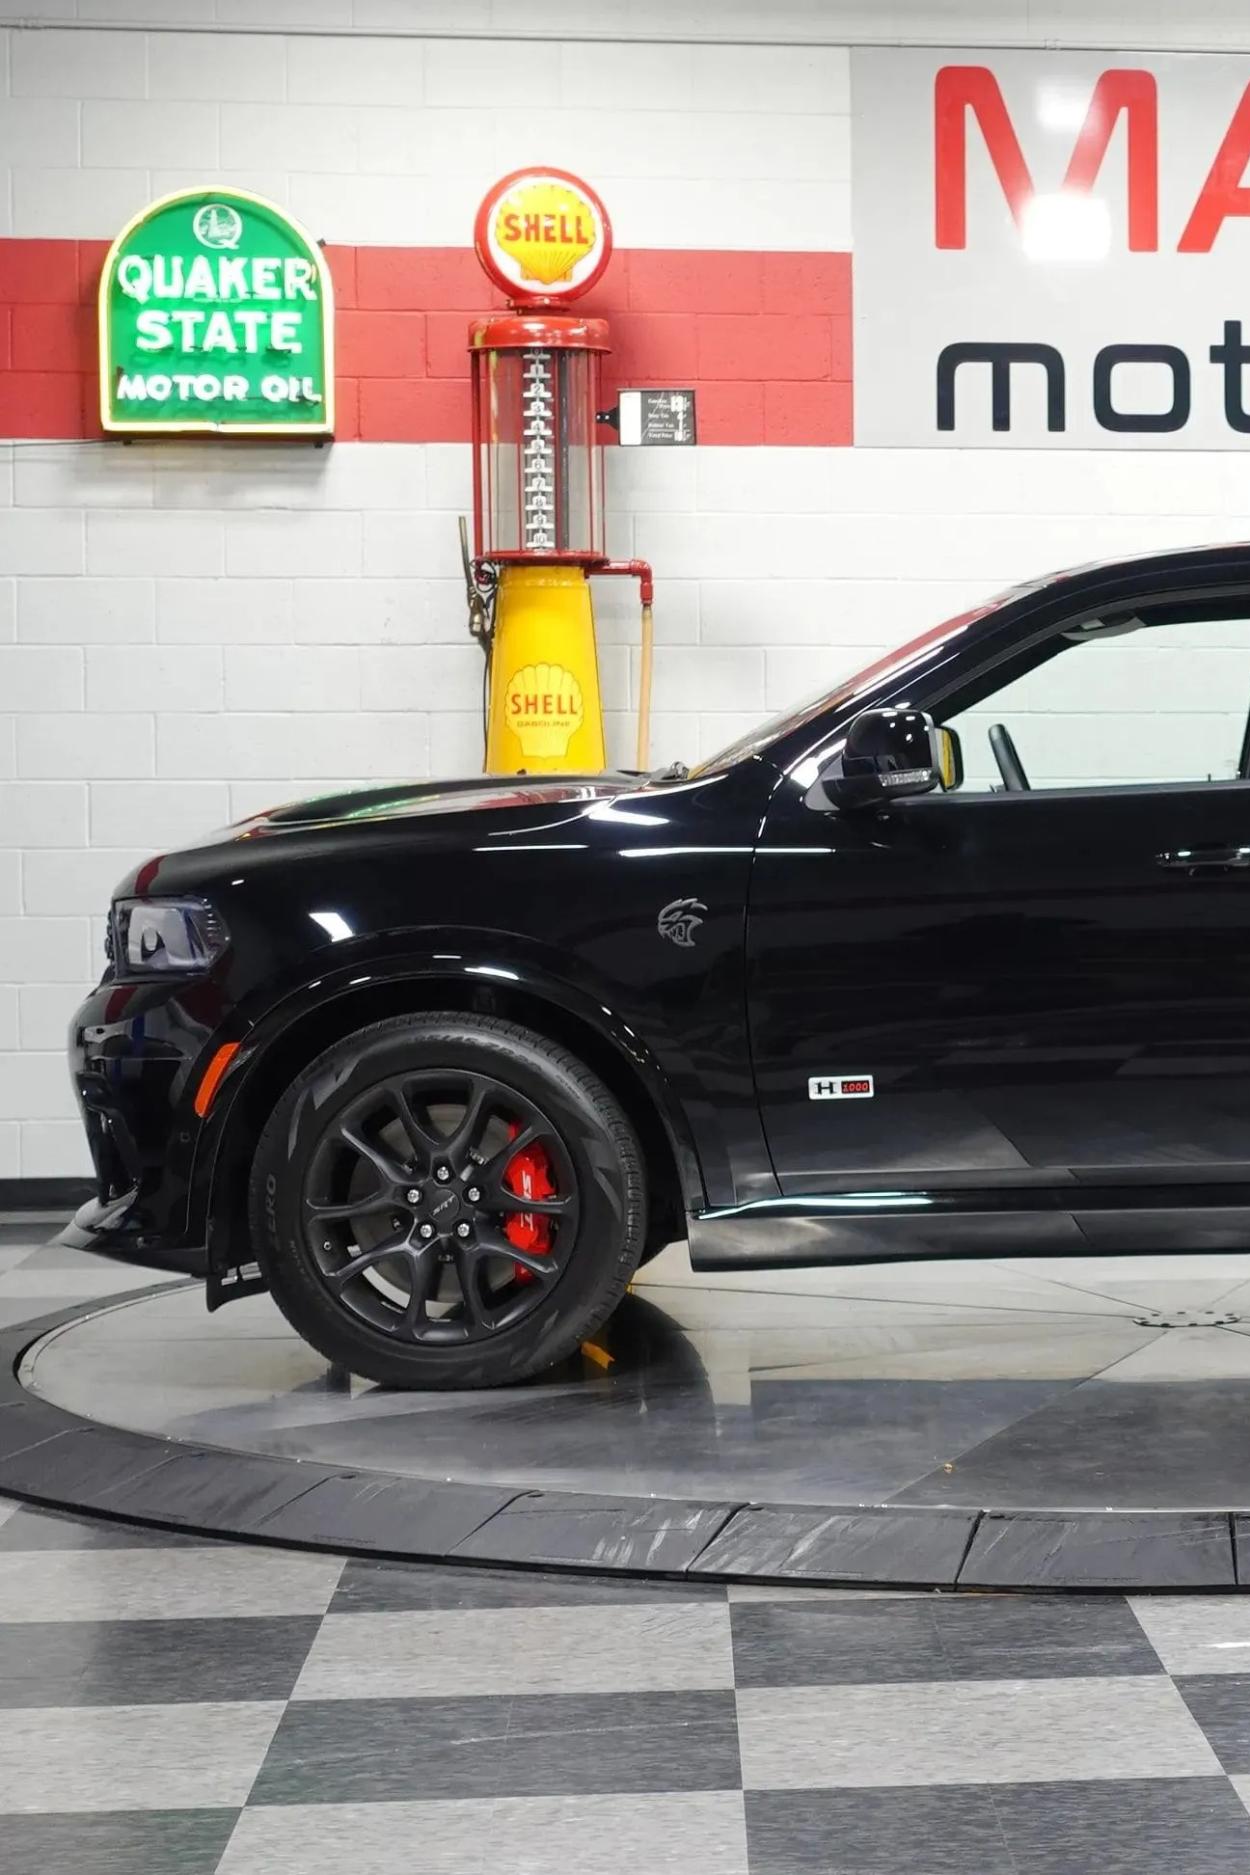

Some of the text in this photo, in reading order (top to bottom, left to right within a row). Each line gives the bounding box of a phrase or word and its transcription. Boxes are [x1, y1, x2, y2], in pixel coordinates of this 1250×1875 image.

[504, 213, 589, 245] SHELL
[117, 254, 318, 304] QUAKER
[136, 310, 303, 354] STATE
[117, 374, 323, 403] MOTOR OIL
[511, 693, 578, 715] SHELL
[814, 1081, 869, 1095] H 1000
